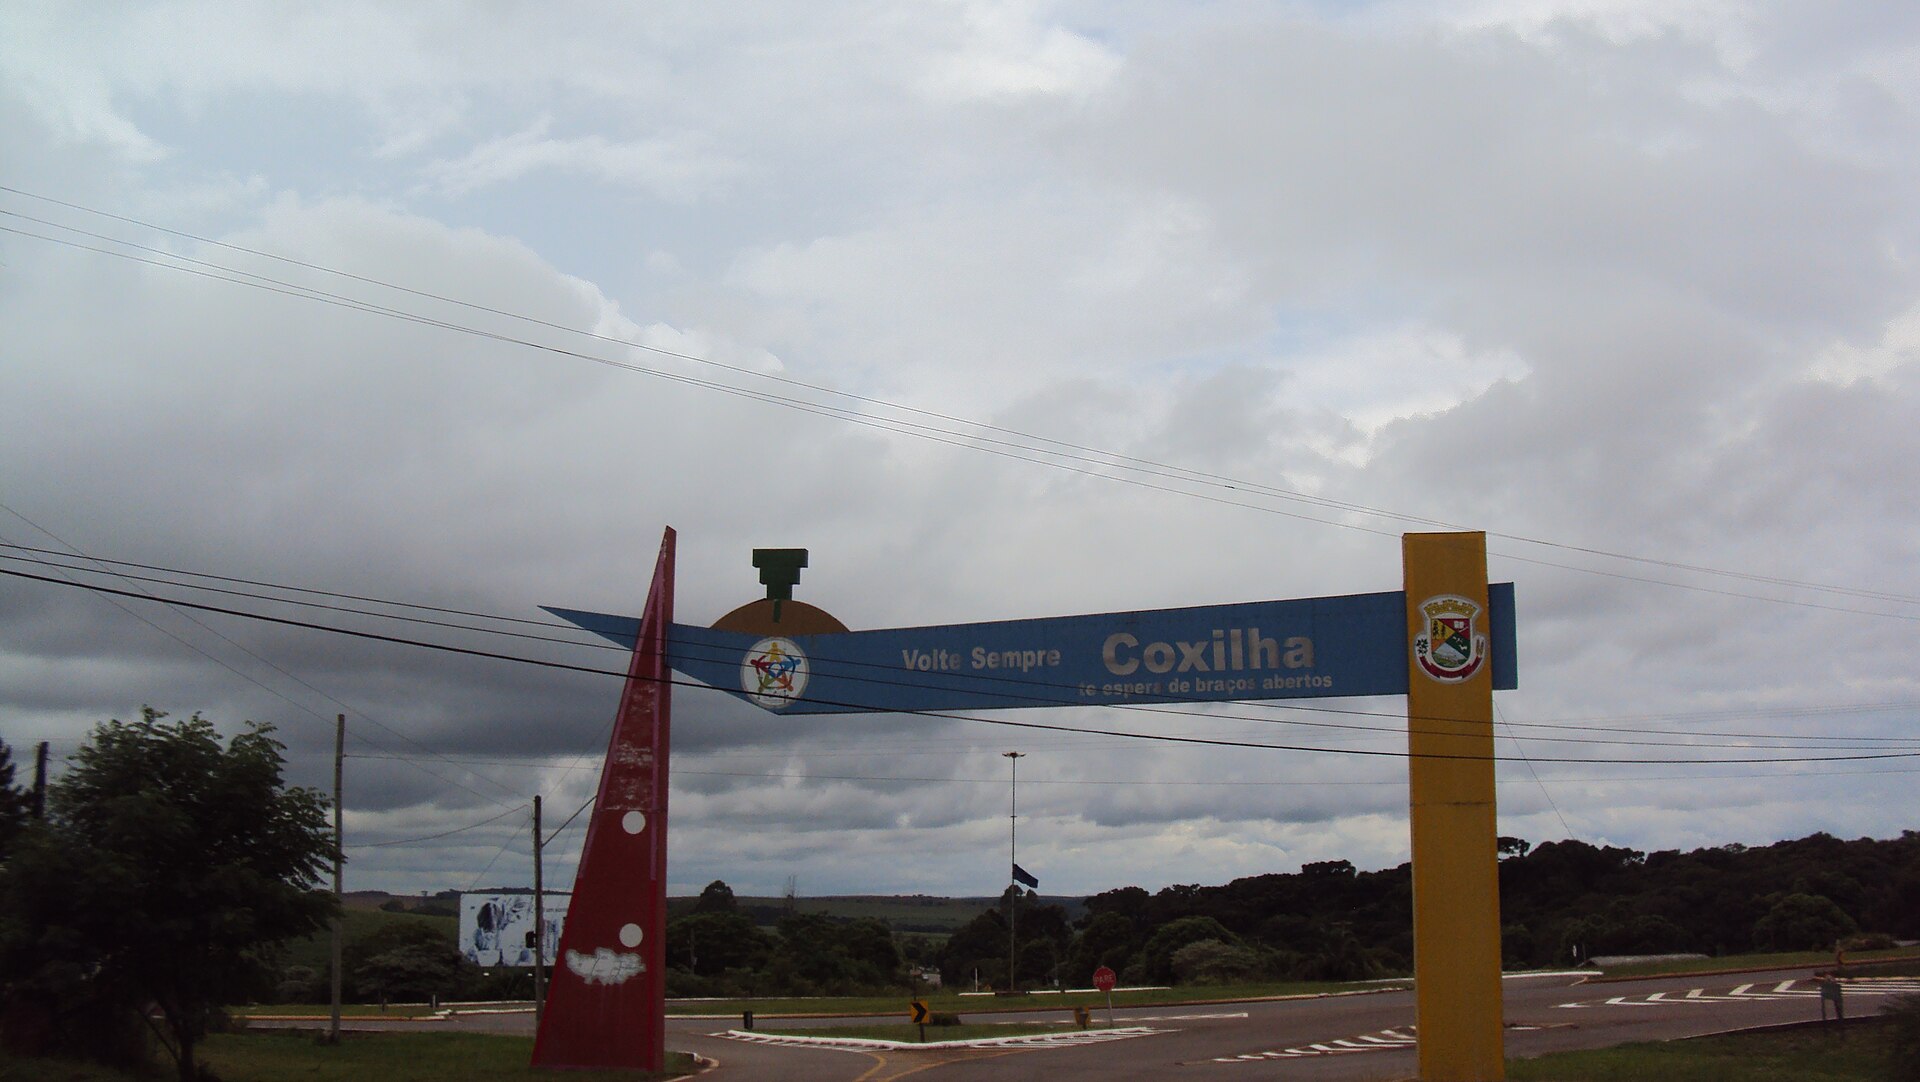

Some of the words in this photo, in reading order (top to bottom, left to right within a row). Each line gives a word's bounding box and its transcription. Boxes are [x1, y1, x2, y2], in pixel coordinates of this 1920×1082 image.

[902, 649, 961, 671] Volte
[971, 646, 1061, 672] Sempre
[1102, 629, 1315, 676] Coxilha
[1080, 683, 1097, 696] te
[1102, 682, 1162, 699] espera
[1168, 677, 1190, 694] de
[1195, 675, 1256, 695] braços
[1262, 673, 1332, 690] abertos
[1094, 974, 1114, 984] PARE
